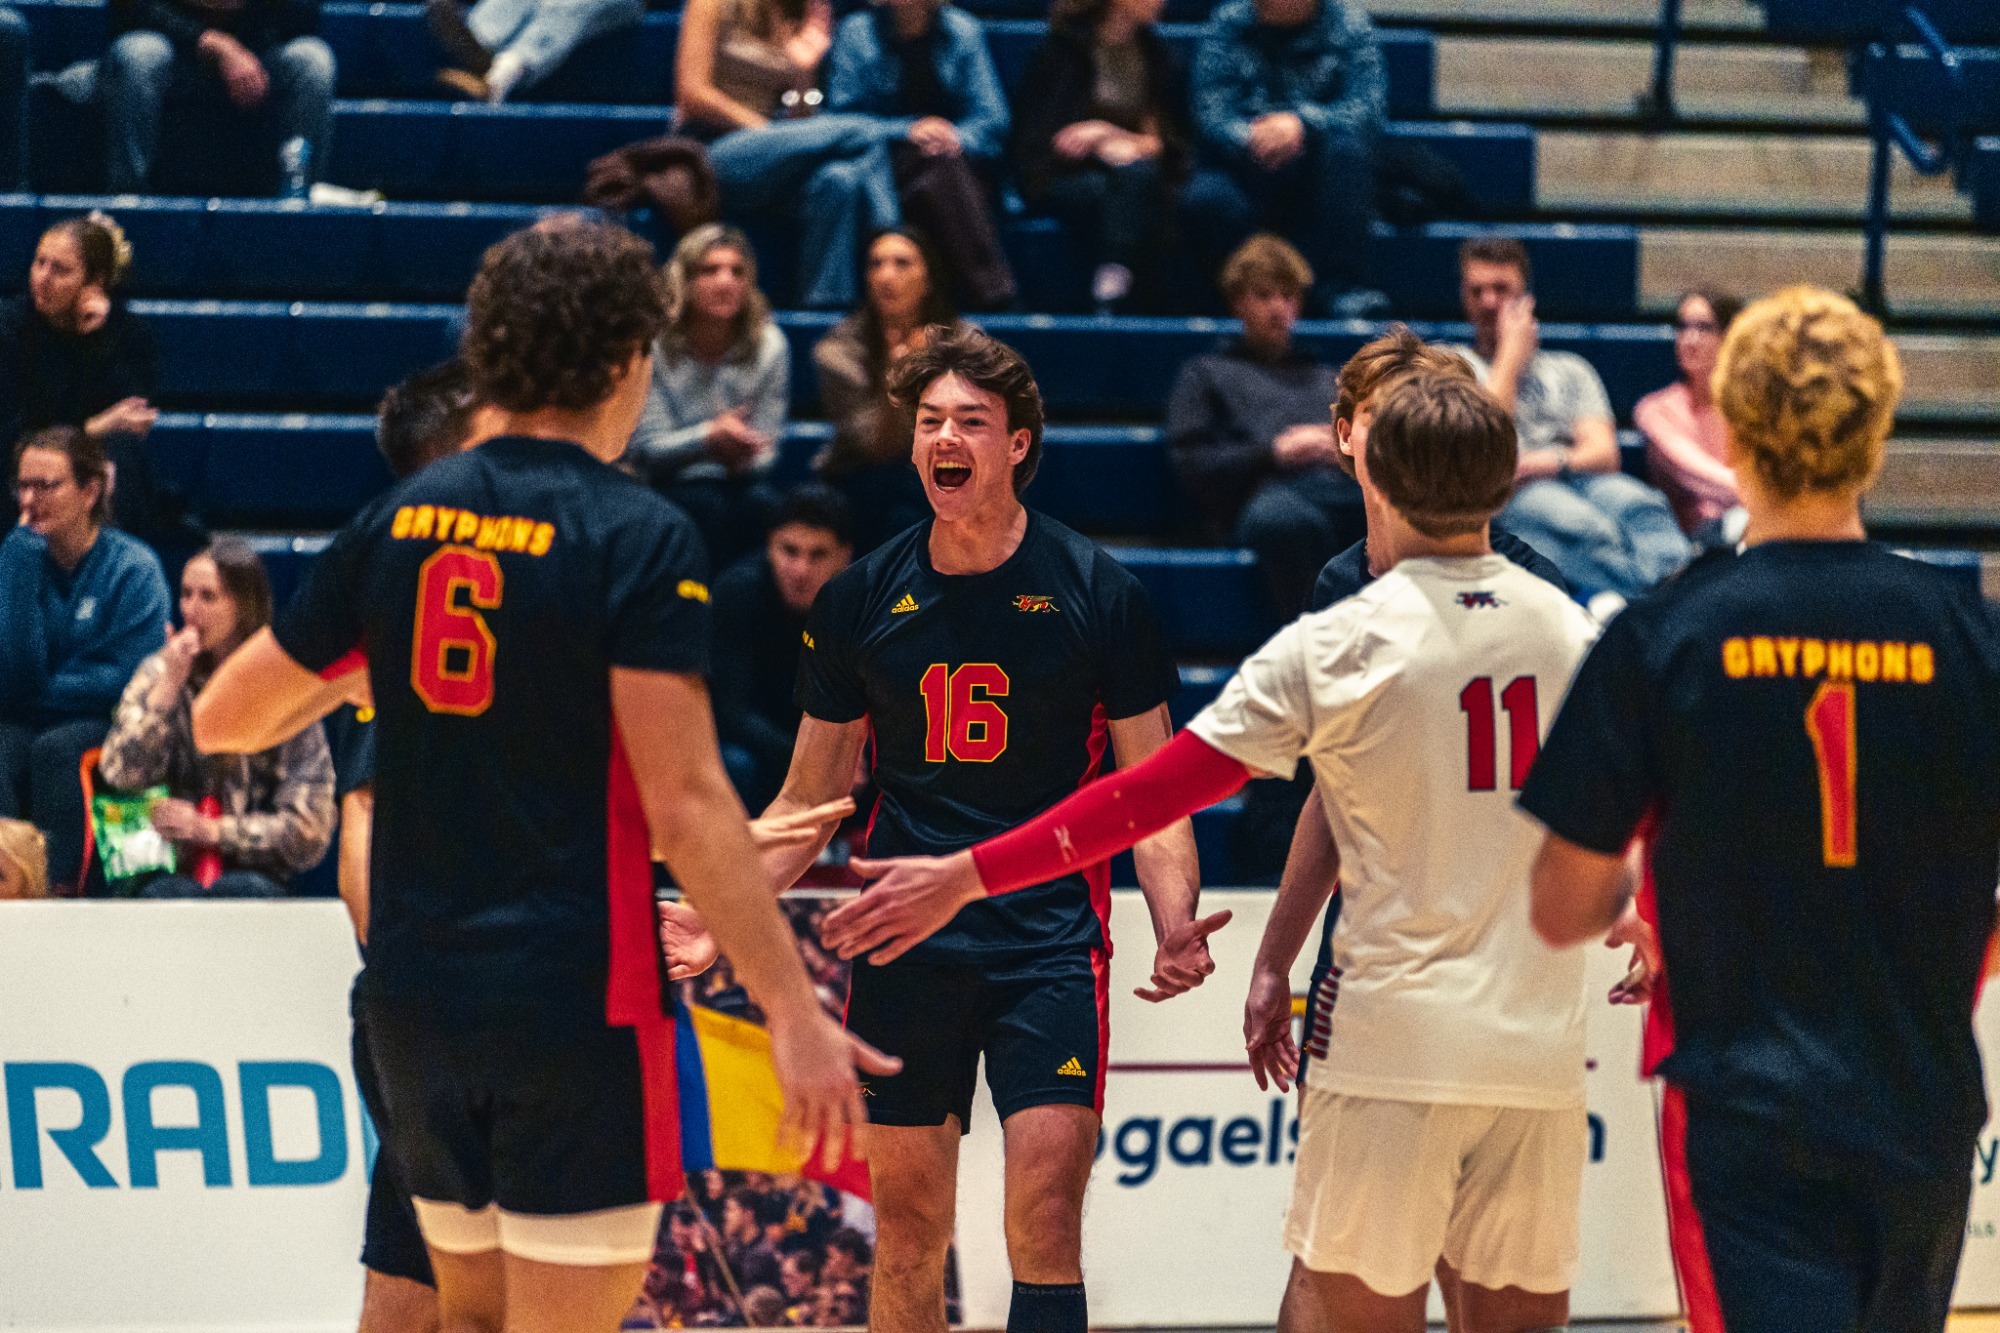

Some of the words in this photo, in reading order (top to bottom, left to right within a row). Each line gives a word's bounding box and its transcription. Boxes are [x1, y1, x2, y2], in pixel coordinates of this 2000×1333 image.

[410, 543, 504, 717] 6
[891, 604, 920, 614] adidas
[1722, 635, 1935, 684] GRYPHONS
[919, 663, 1010, 762] 16
[1459, 675, 1540, 792] 11
[1804, 680, 1857, 866] 1
[0, 1060, 380, 1190] RAD
[1056, 1068, 1087, 1077] adidas
